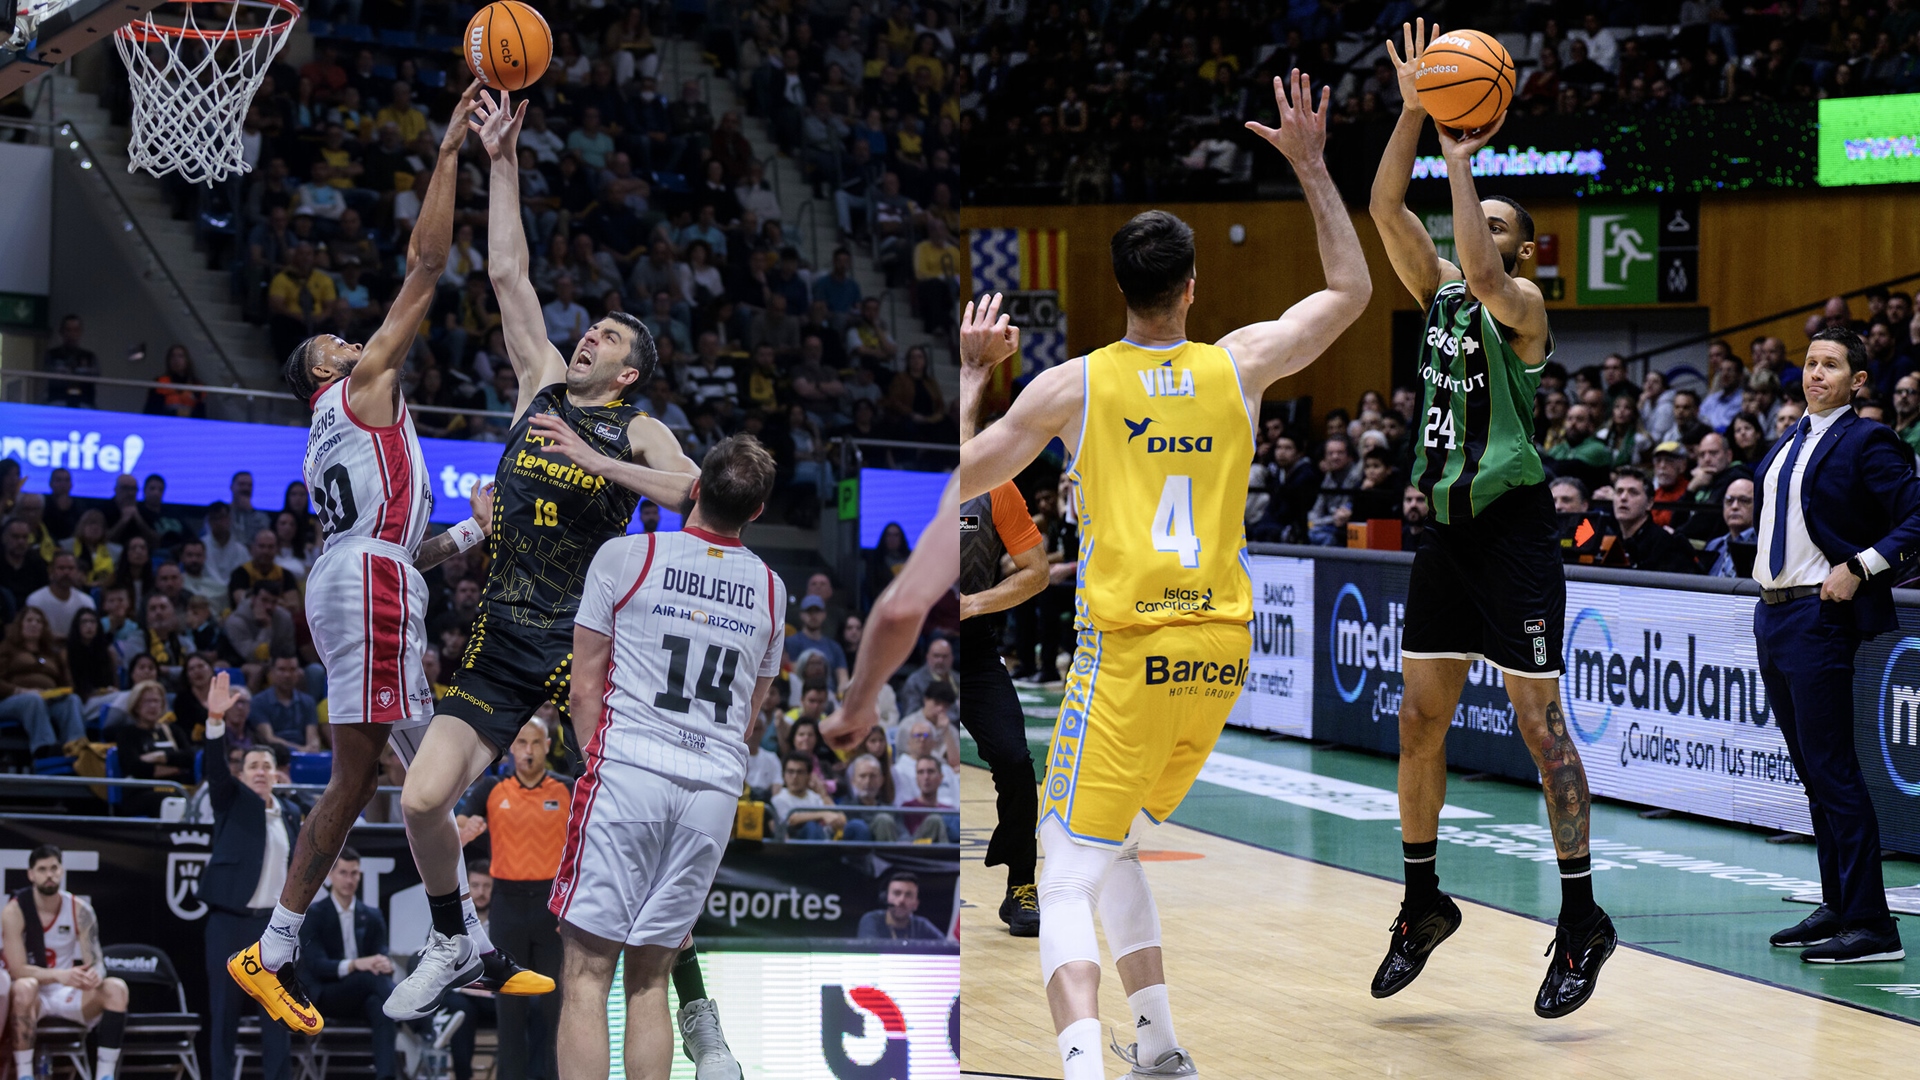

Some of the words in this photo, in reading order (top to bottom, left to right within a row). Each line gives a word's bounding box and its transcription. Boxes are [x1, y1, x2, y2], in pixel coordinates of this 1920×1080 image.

[471, 25, 490, 83] Wilson
[500, 39, 512, 64] acb
[1137, 367, 1196, 398] VILA
[1423, 406, 1457, 450] 24
[0, 430, 145, 475] nerife!
[513, 466, 548, 482] despierta
[1151, 475, 1201, 568] 4
[662, 567, 755, 611] DUBLJEVIC
[1135, 599, 1200, 614] Canarias
[1164, 587, 1199, 601] Islas
[1263, 582, 1296, 607] BANCO
[652, 603, 676, 618] AIR
[680, 608, 756, 637] HORIZONT
[1337, 602, 1405, 673] medi
[653, 633, 740, 725] 14
[1169, 686, 1198, 698] HOTEL
[1204, 688, 1235, 700] GROUP
[1574, 629, 1781, 728] mediolanu
[456, 688, 495, 715] Hospiten
[1467, 700, 1516, 737] metas?
[1620, 722, 1681, 768] ¿Cuáles
[1686, 740, 1715, 773] son
[1720, 738, 1745, 777] tus
[702, 887, 842, 927] eportes
